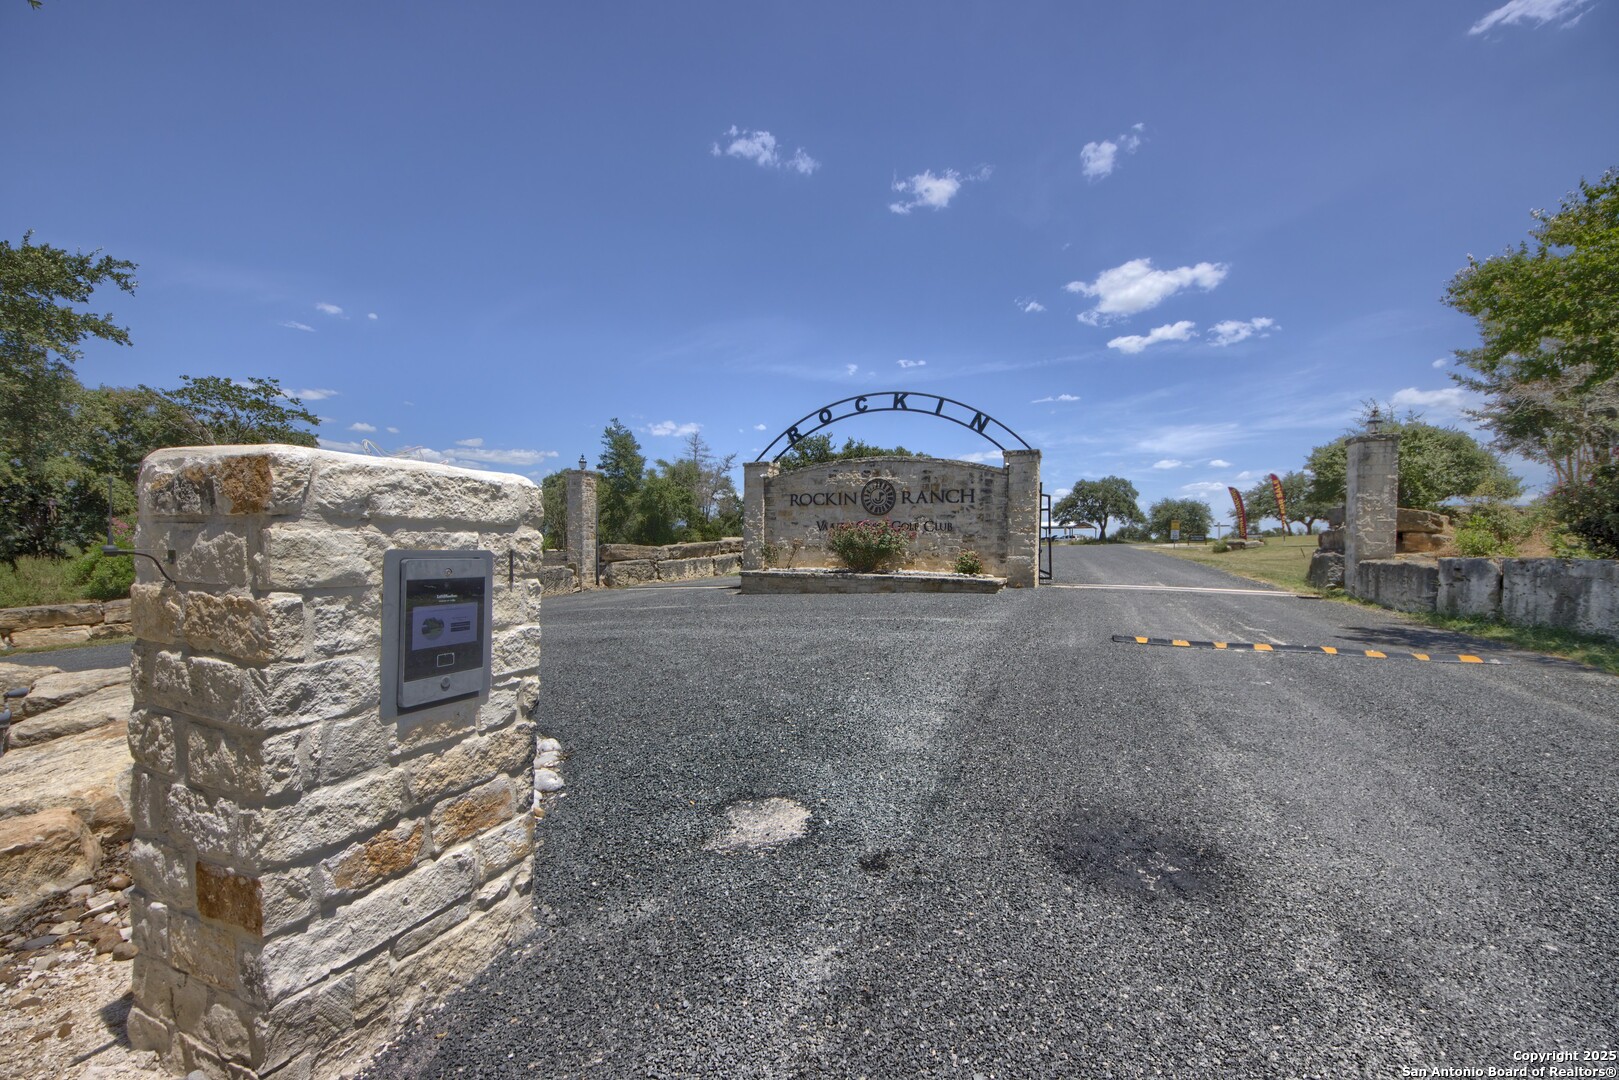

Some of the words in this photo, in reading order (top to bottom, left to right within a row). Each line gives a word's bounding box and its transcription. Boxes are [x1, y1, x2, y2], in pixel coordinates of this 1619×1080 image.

[786, 391, 991, 444] ROCKIN
[789, 492, 857, 507] ROCKIN
[901, 489, 975, 504] RANCH
[1272, 479, 1283, 499] SALE
